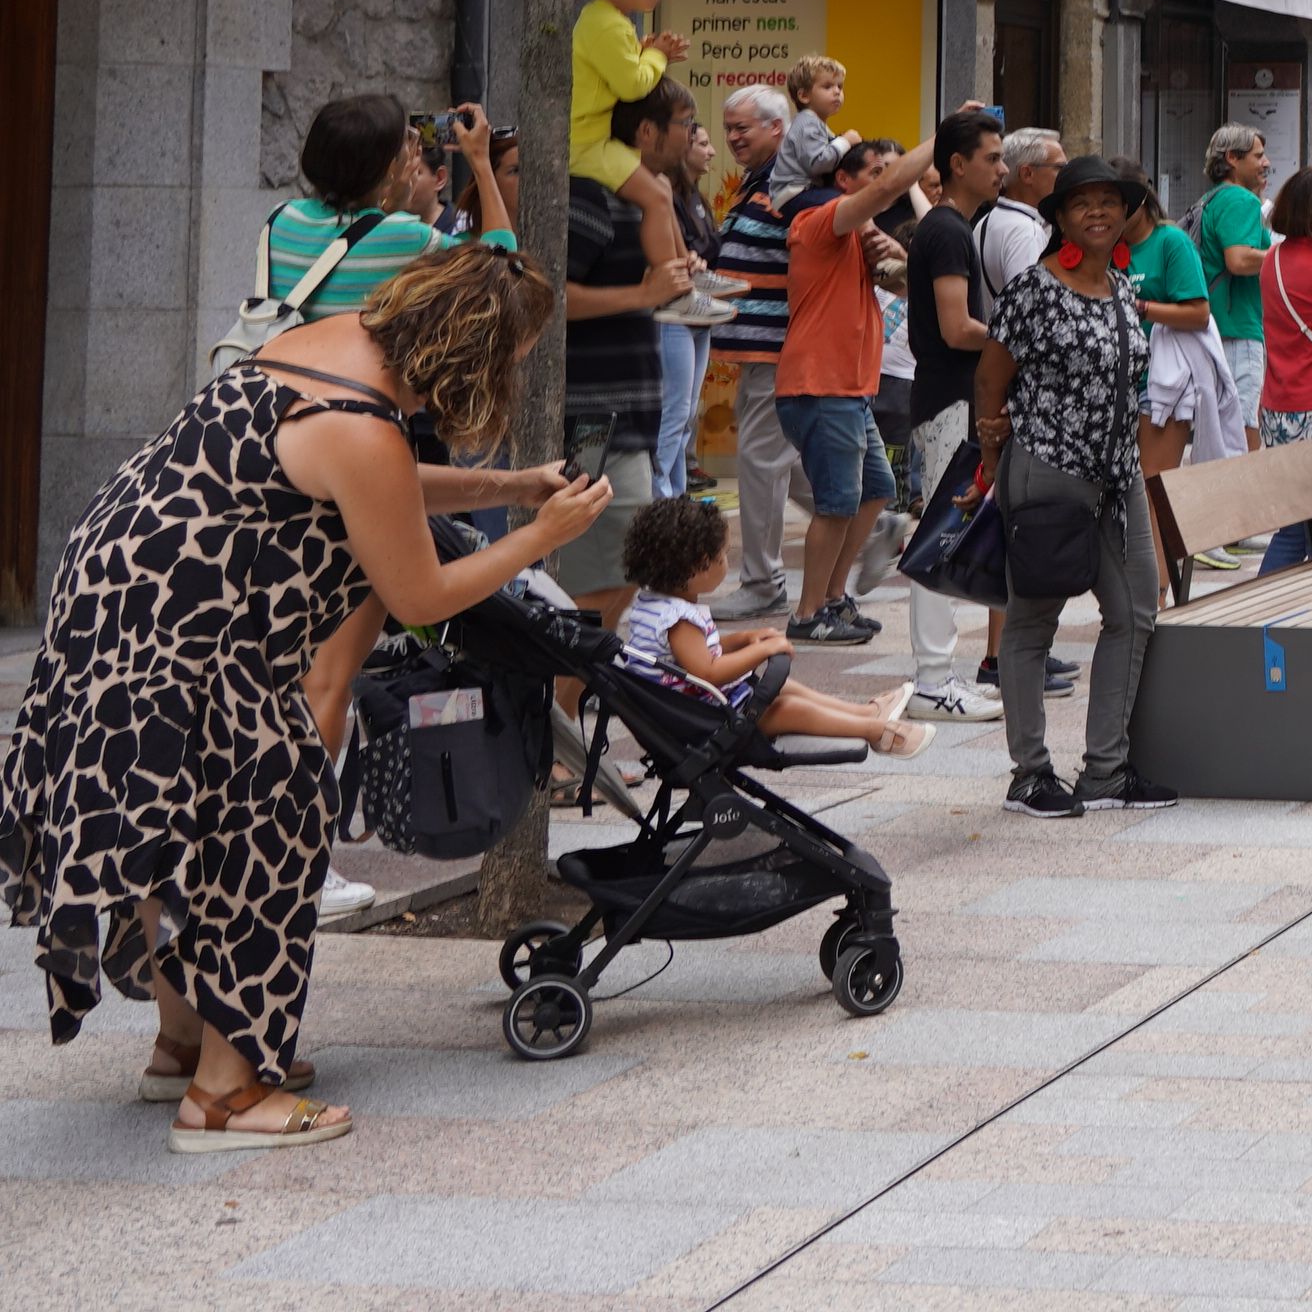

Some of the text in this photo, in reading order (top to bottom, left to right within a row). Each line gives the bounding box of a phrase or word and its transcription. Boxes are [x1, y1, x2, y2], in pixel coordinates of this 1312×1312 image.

[692, 13, 800, 35] primer nens.
[702, 39, 789, 63] Però pocs
[689, 69, 787, 87] ho recorde
